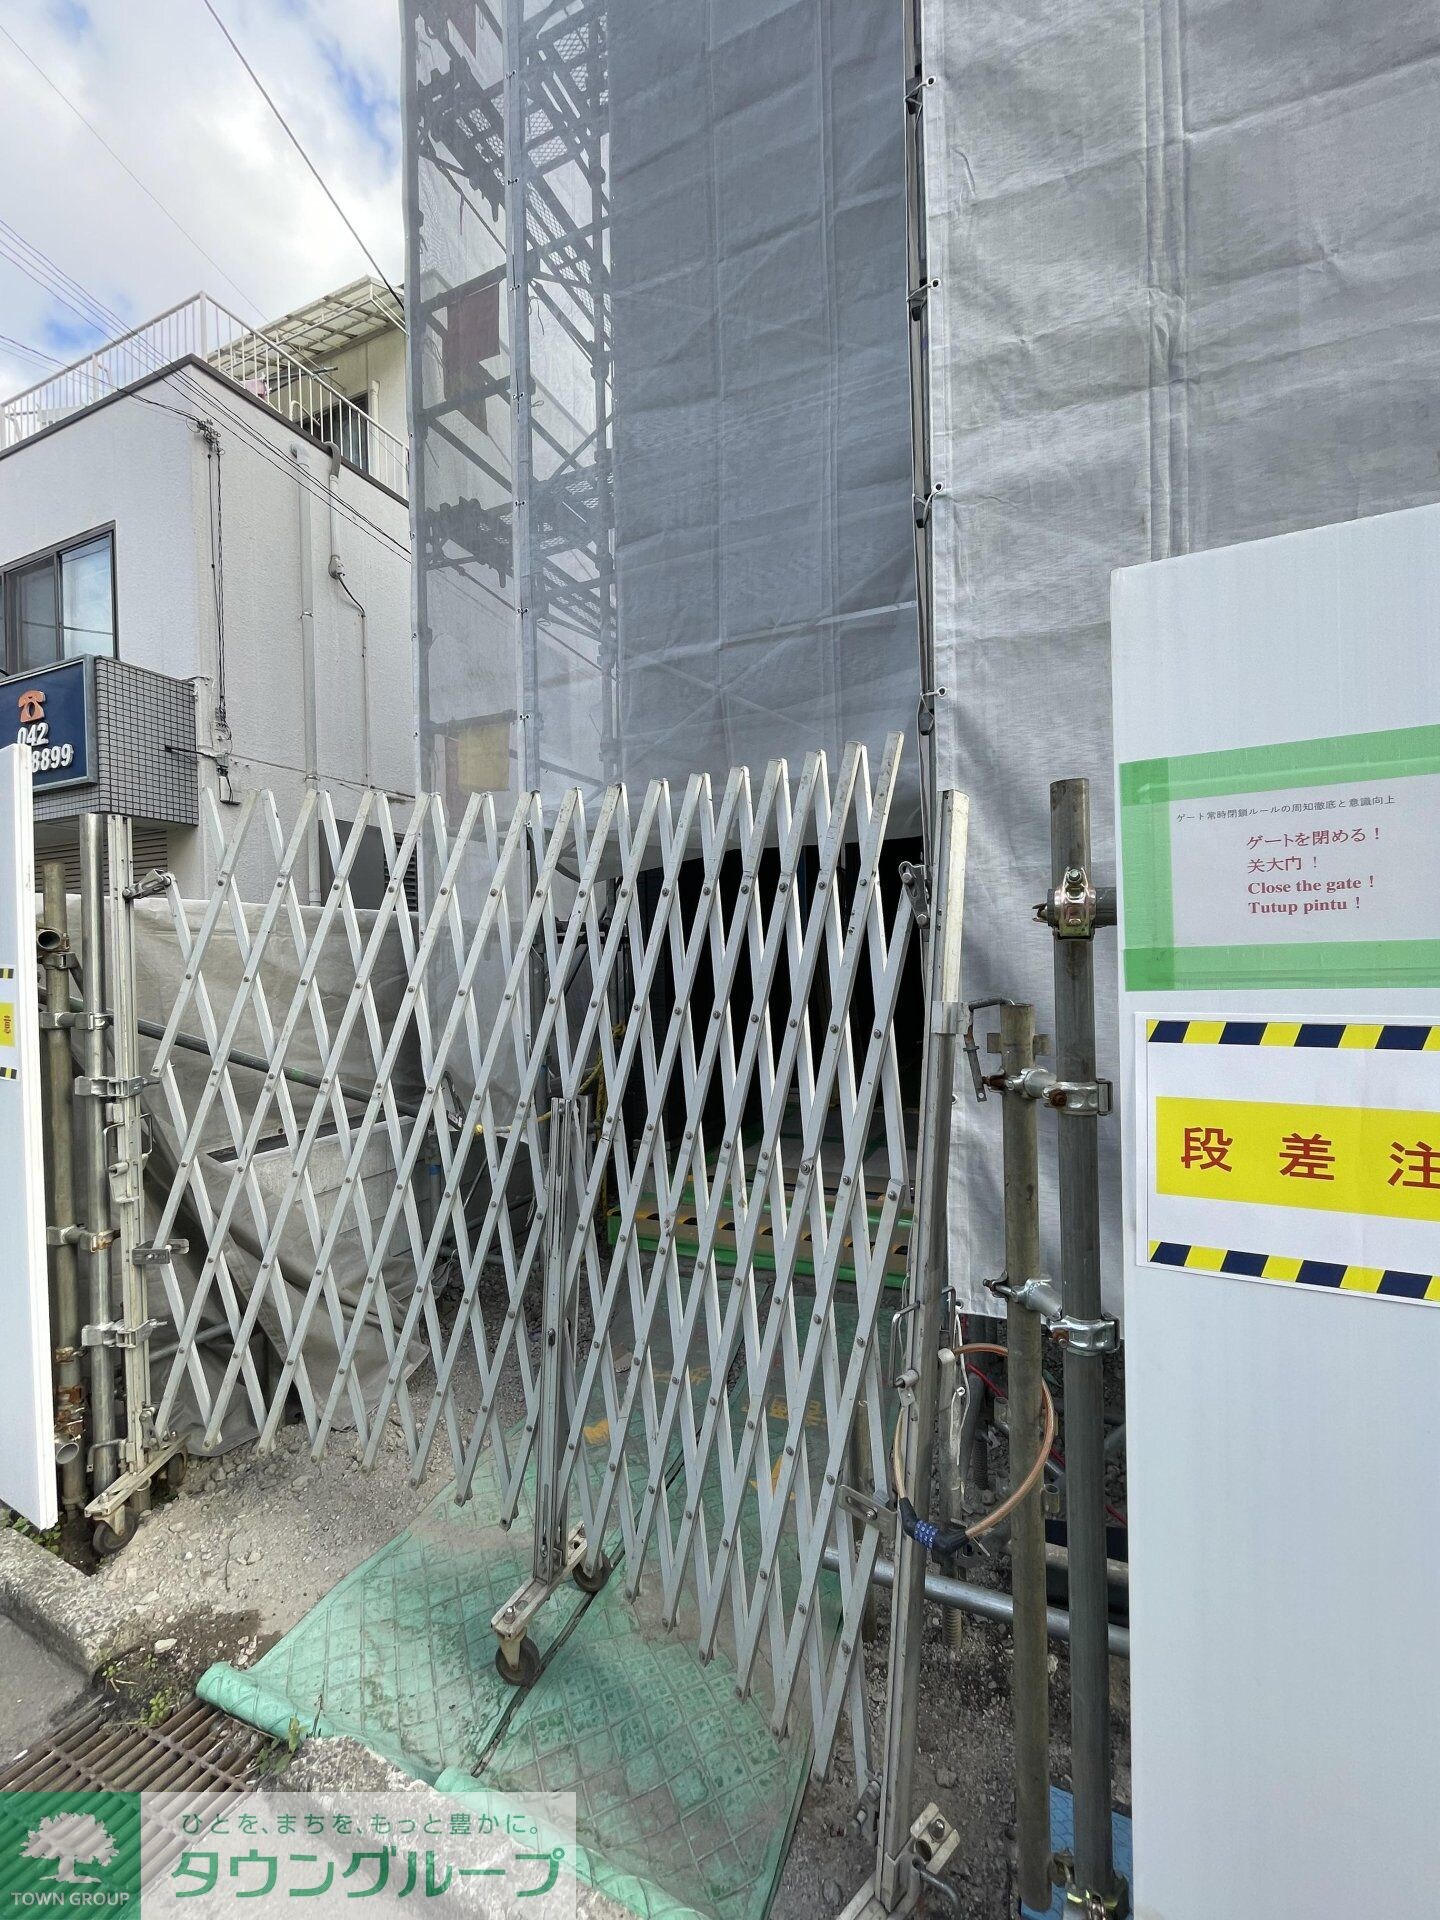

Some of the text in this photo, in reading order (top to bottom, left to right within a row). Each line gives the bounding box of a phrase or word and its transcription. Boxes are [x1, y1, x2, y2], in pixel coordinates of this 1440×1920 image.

[17, 722, 49, 746] 042
[1247, 882, 1291, 894] Close
[1296, 879, 1322, 892] the
[1248, 901, 1298, 915] Tutup
